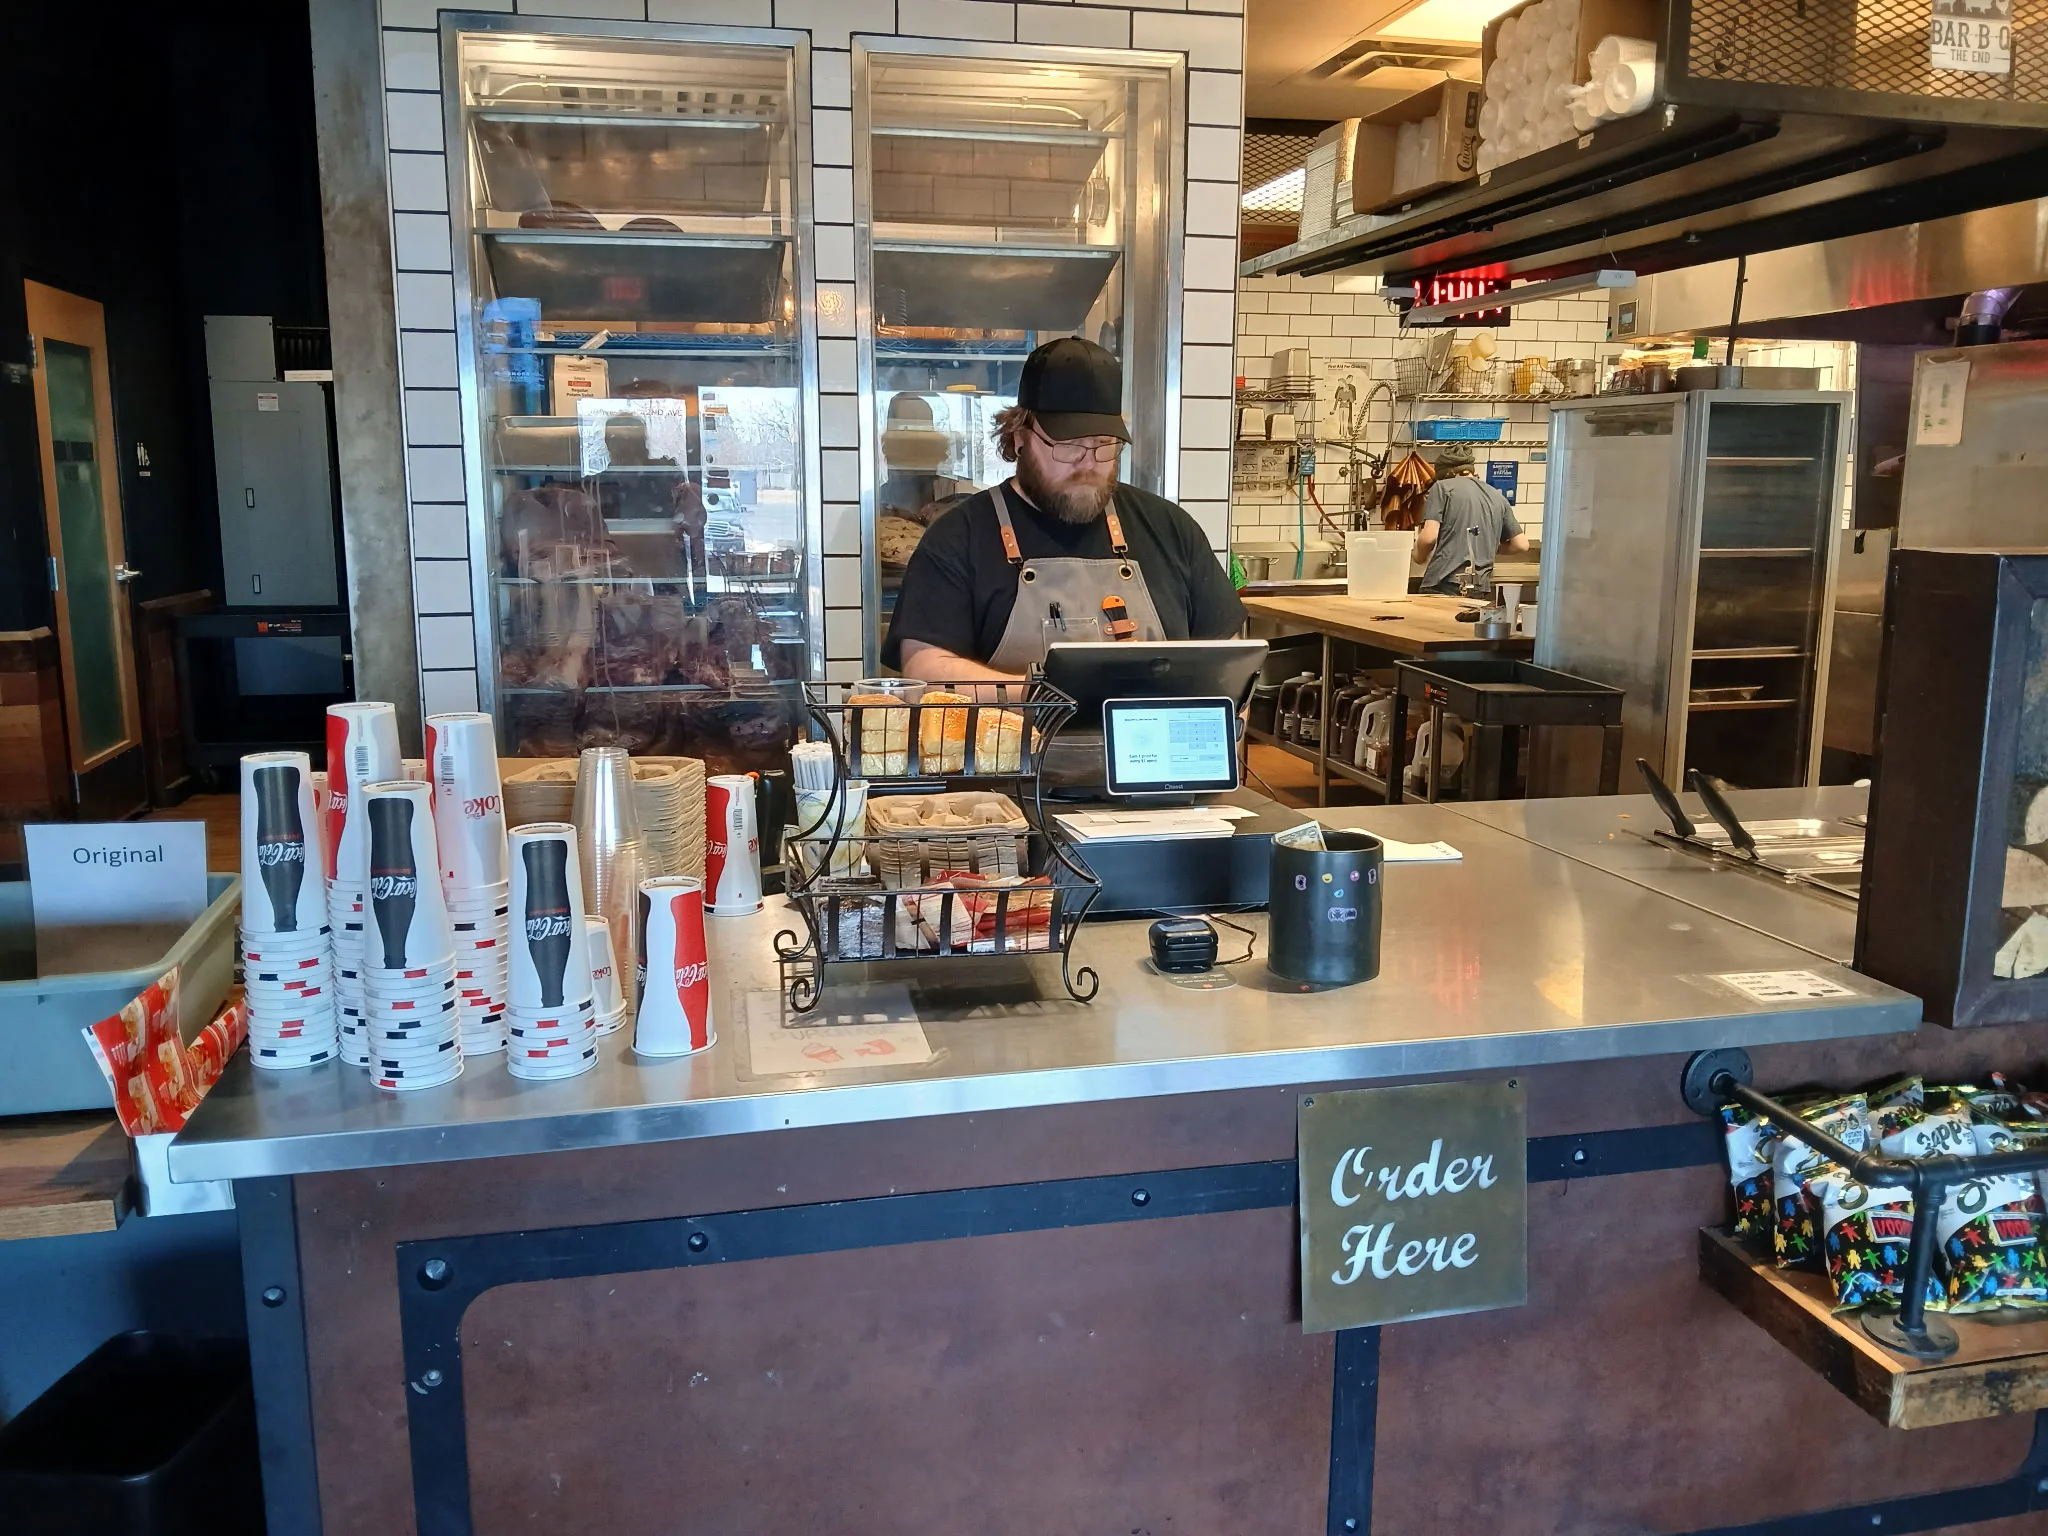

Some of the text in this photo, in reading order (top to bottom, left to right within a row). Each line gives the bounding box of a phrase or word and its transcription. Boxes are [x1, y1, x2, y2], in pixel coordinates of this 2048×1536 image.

[1950, 49, 1991, 63] THE END
[73, 844, 163, 867] Original
[1331, 1138, 1498, 1208] Order
[1331, 1222, 1479, 1285] Here
